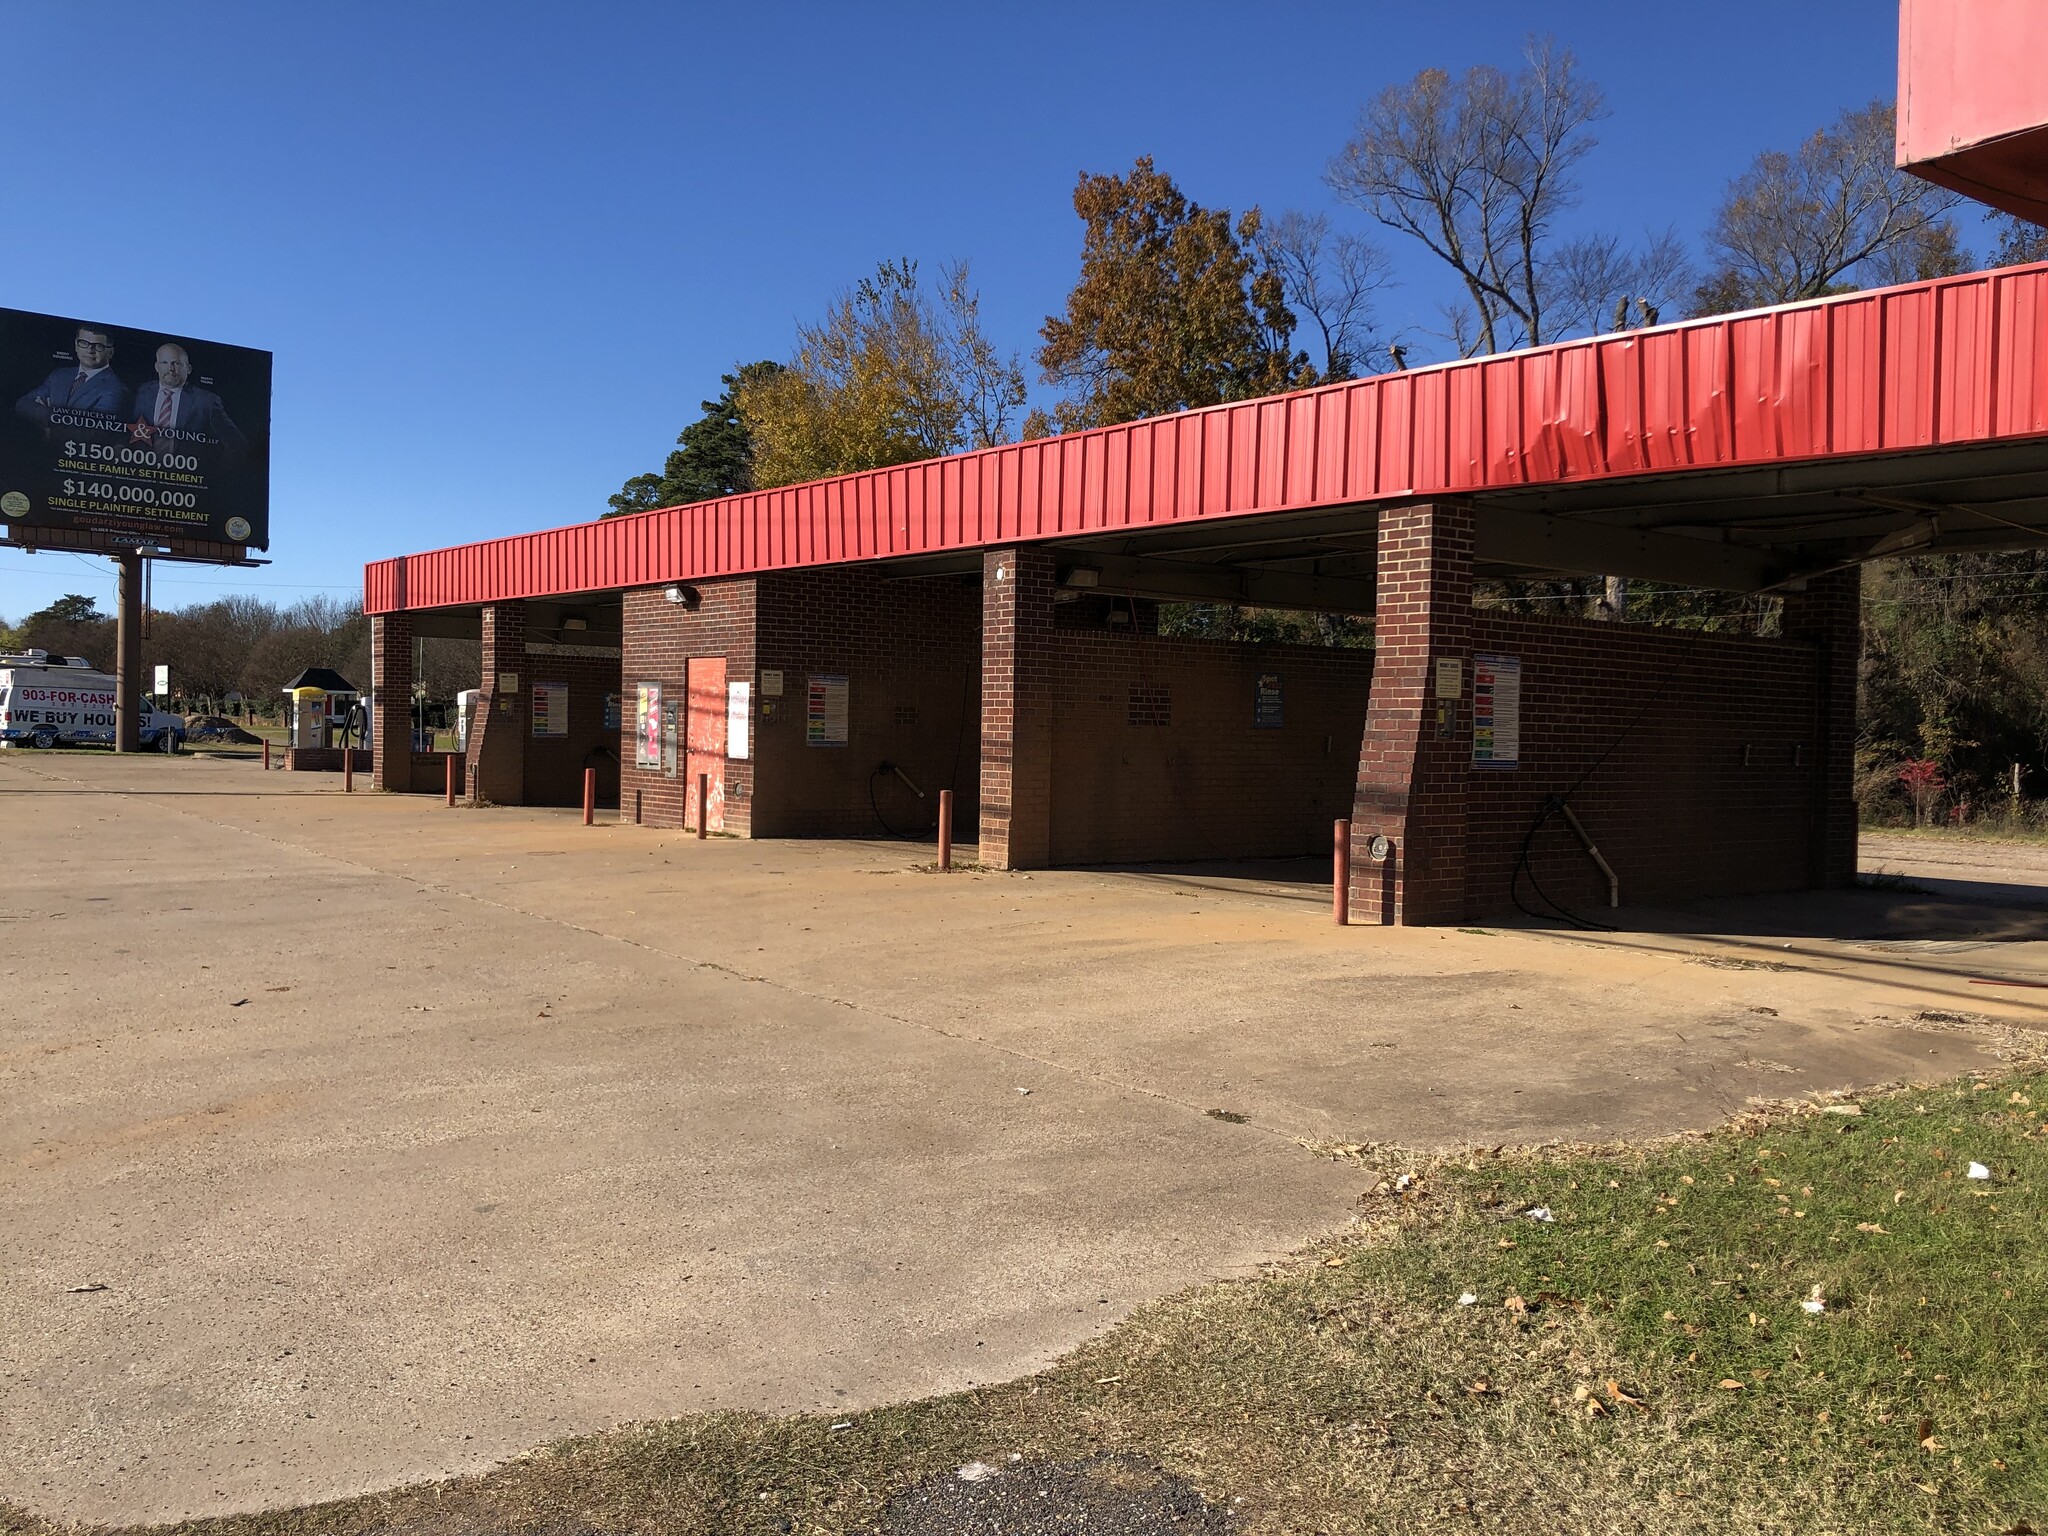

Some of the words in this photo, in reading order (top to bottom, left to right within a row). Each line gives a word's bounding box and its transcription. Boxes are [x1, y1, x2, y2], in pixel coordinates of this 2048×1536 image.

[53, 407, 69, 415] LAW
[71, 409, 105, 419] OFFICES
[50, 413, 128, 433] GOUDARZI
[133, 424, 152, 439] &
[57, 458, 97, 472] SINGLE
[99, 464, 137, 477] FAMILY
[138, 469, 205, 484] SETTLEMENT
[47, 496, 87, 509] SINGLE
[89, 500, 143, 515] PLAINTIFF
[144, 507, 211, 522] SETTLEMENT
[72, 516, 184, 533] goudarziyounglaw.com
[115, 537, 155, 546] LAMAR
[22, 689, 116, 704] 903-FOR-CASH
[14, 710, 40, 723] WE
[45, 712, 79, 725] BUY
[84, 713, 151, 727] HOUS!
